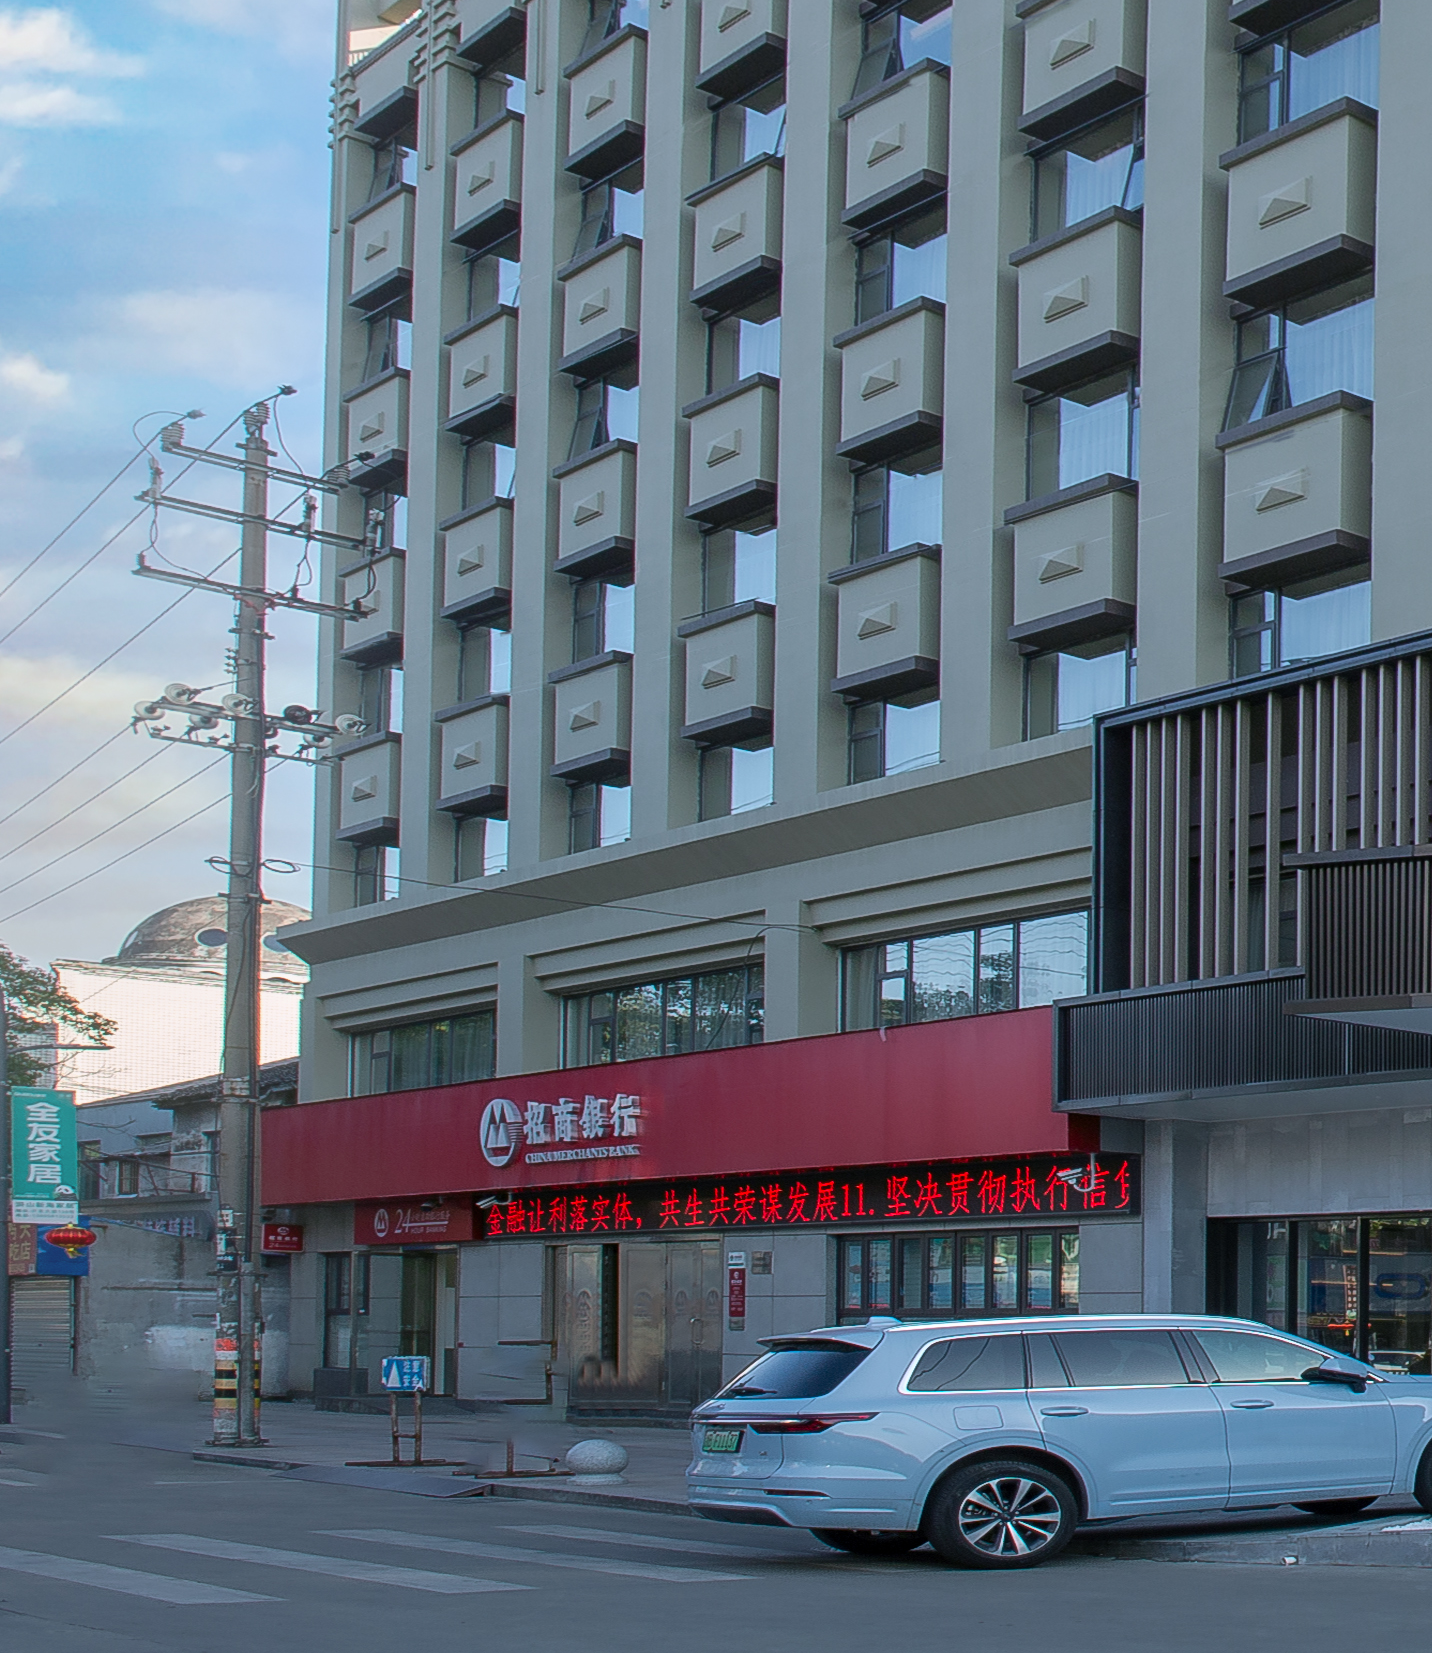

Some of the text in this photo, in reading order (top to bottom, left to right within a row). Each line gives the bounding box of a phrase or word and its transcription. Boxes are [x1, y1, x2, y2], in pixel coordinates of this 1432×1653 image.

[26, 1102, 62, 1184] 全友家居
[523, 1094, 641, 1145] 招商银行
[525, 1152, 550, 1164] CHINA
[551, 1147, 607, 1162] MERCHANTS
